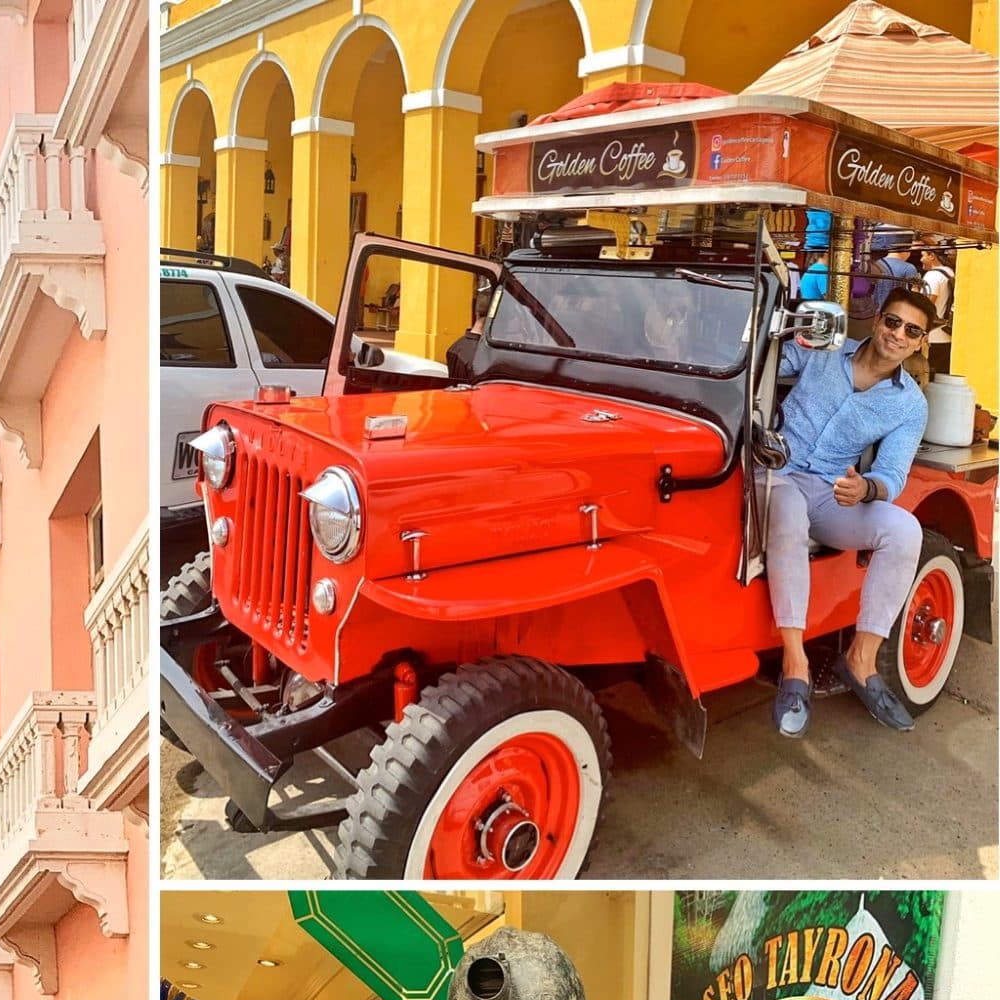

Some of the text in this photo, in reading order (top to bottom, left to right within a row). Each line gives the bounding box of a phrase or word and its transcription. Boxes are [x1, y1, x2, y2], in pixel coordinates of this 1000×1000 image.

[537, 140, 656, 184] Golden Coffee
[837, 148, 936, 206] Golden Coffee
